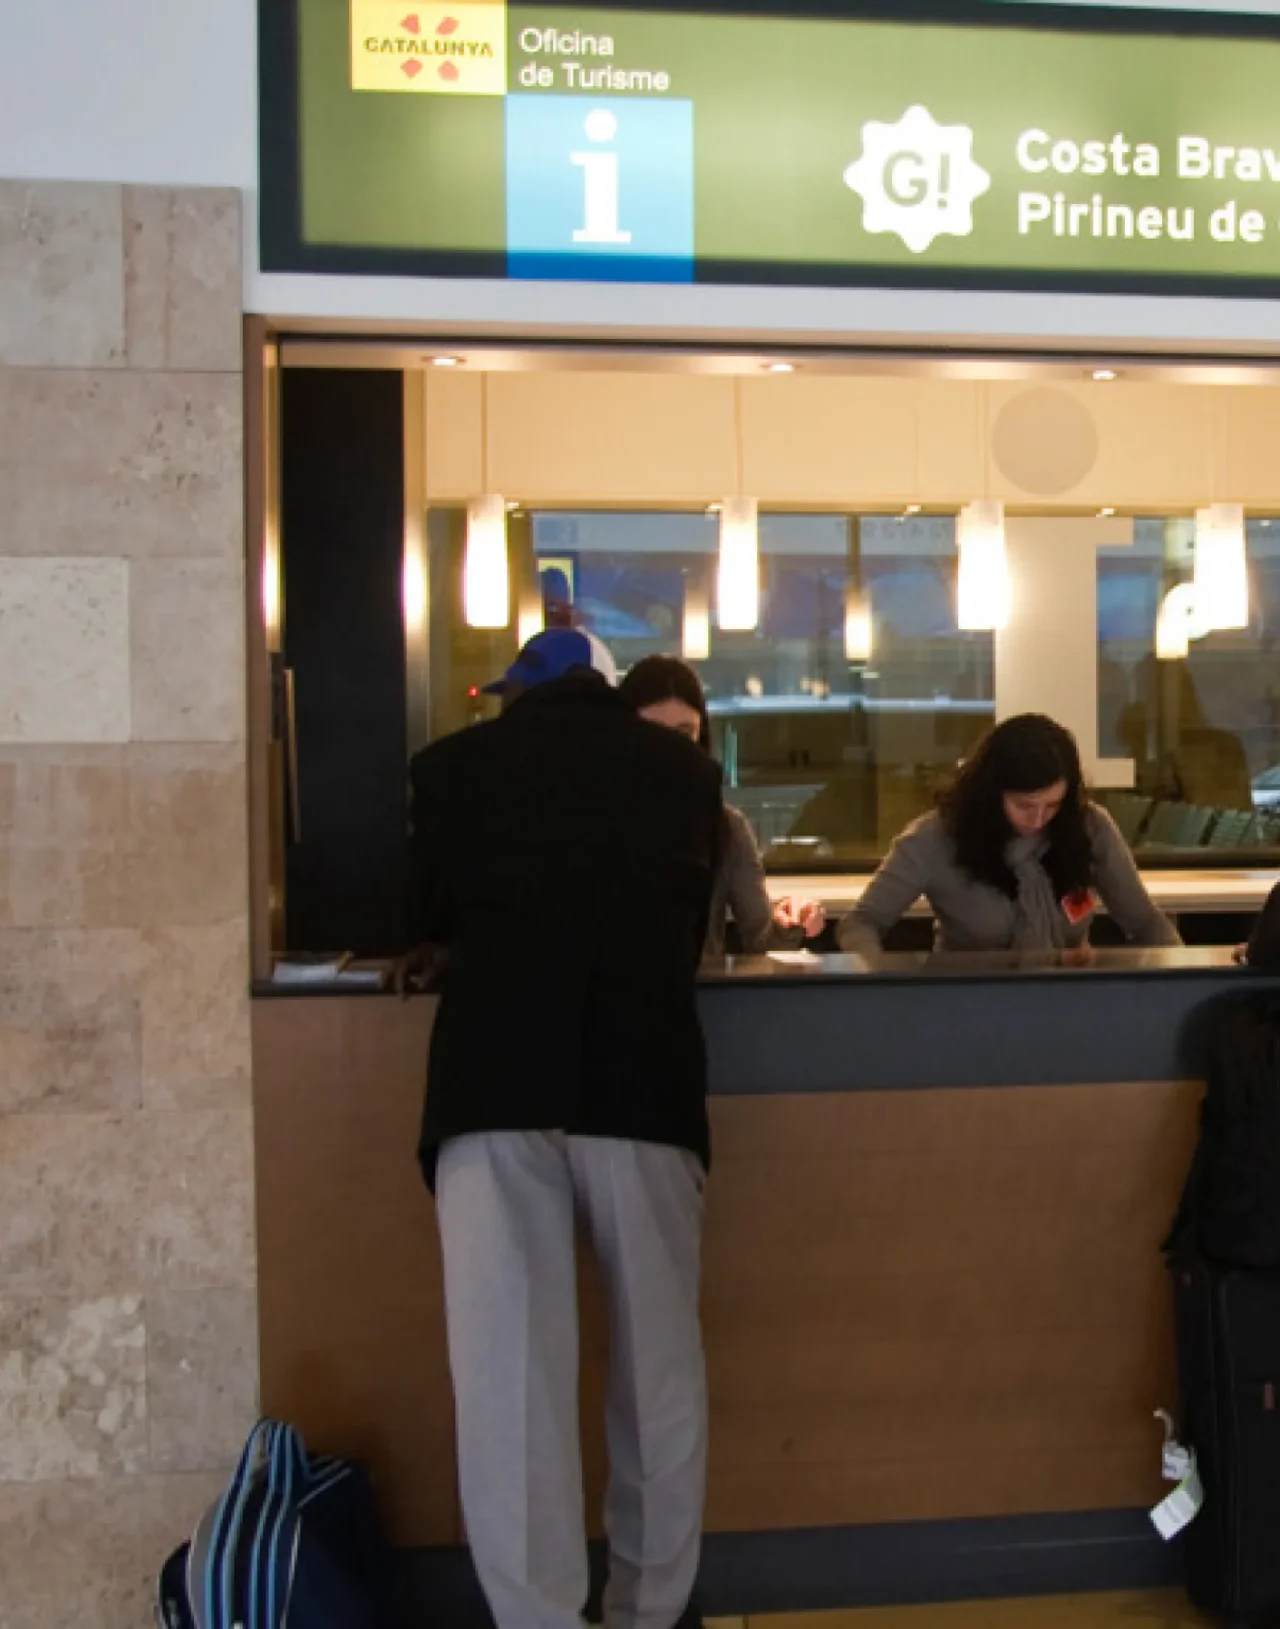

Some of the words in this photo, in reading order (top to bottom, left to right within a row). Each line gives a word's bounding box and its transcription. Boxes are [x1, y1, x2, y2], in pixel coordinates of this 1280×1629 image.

[364, 36, 494, 58] CATALUNYA
[519, 26, 615, 56] Oficina
[519, 61, 554, 88] de
[560, 62, 671, 91] Turisme
[1015, 128, 1161, 177] Costa
[882, 150, 951, 210] G!
[1017, 191, 1195, 239] Pirineu
[1209, 200, 1266, 242] de
